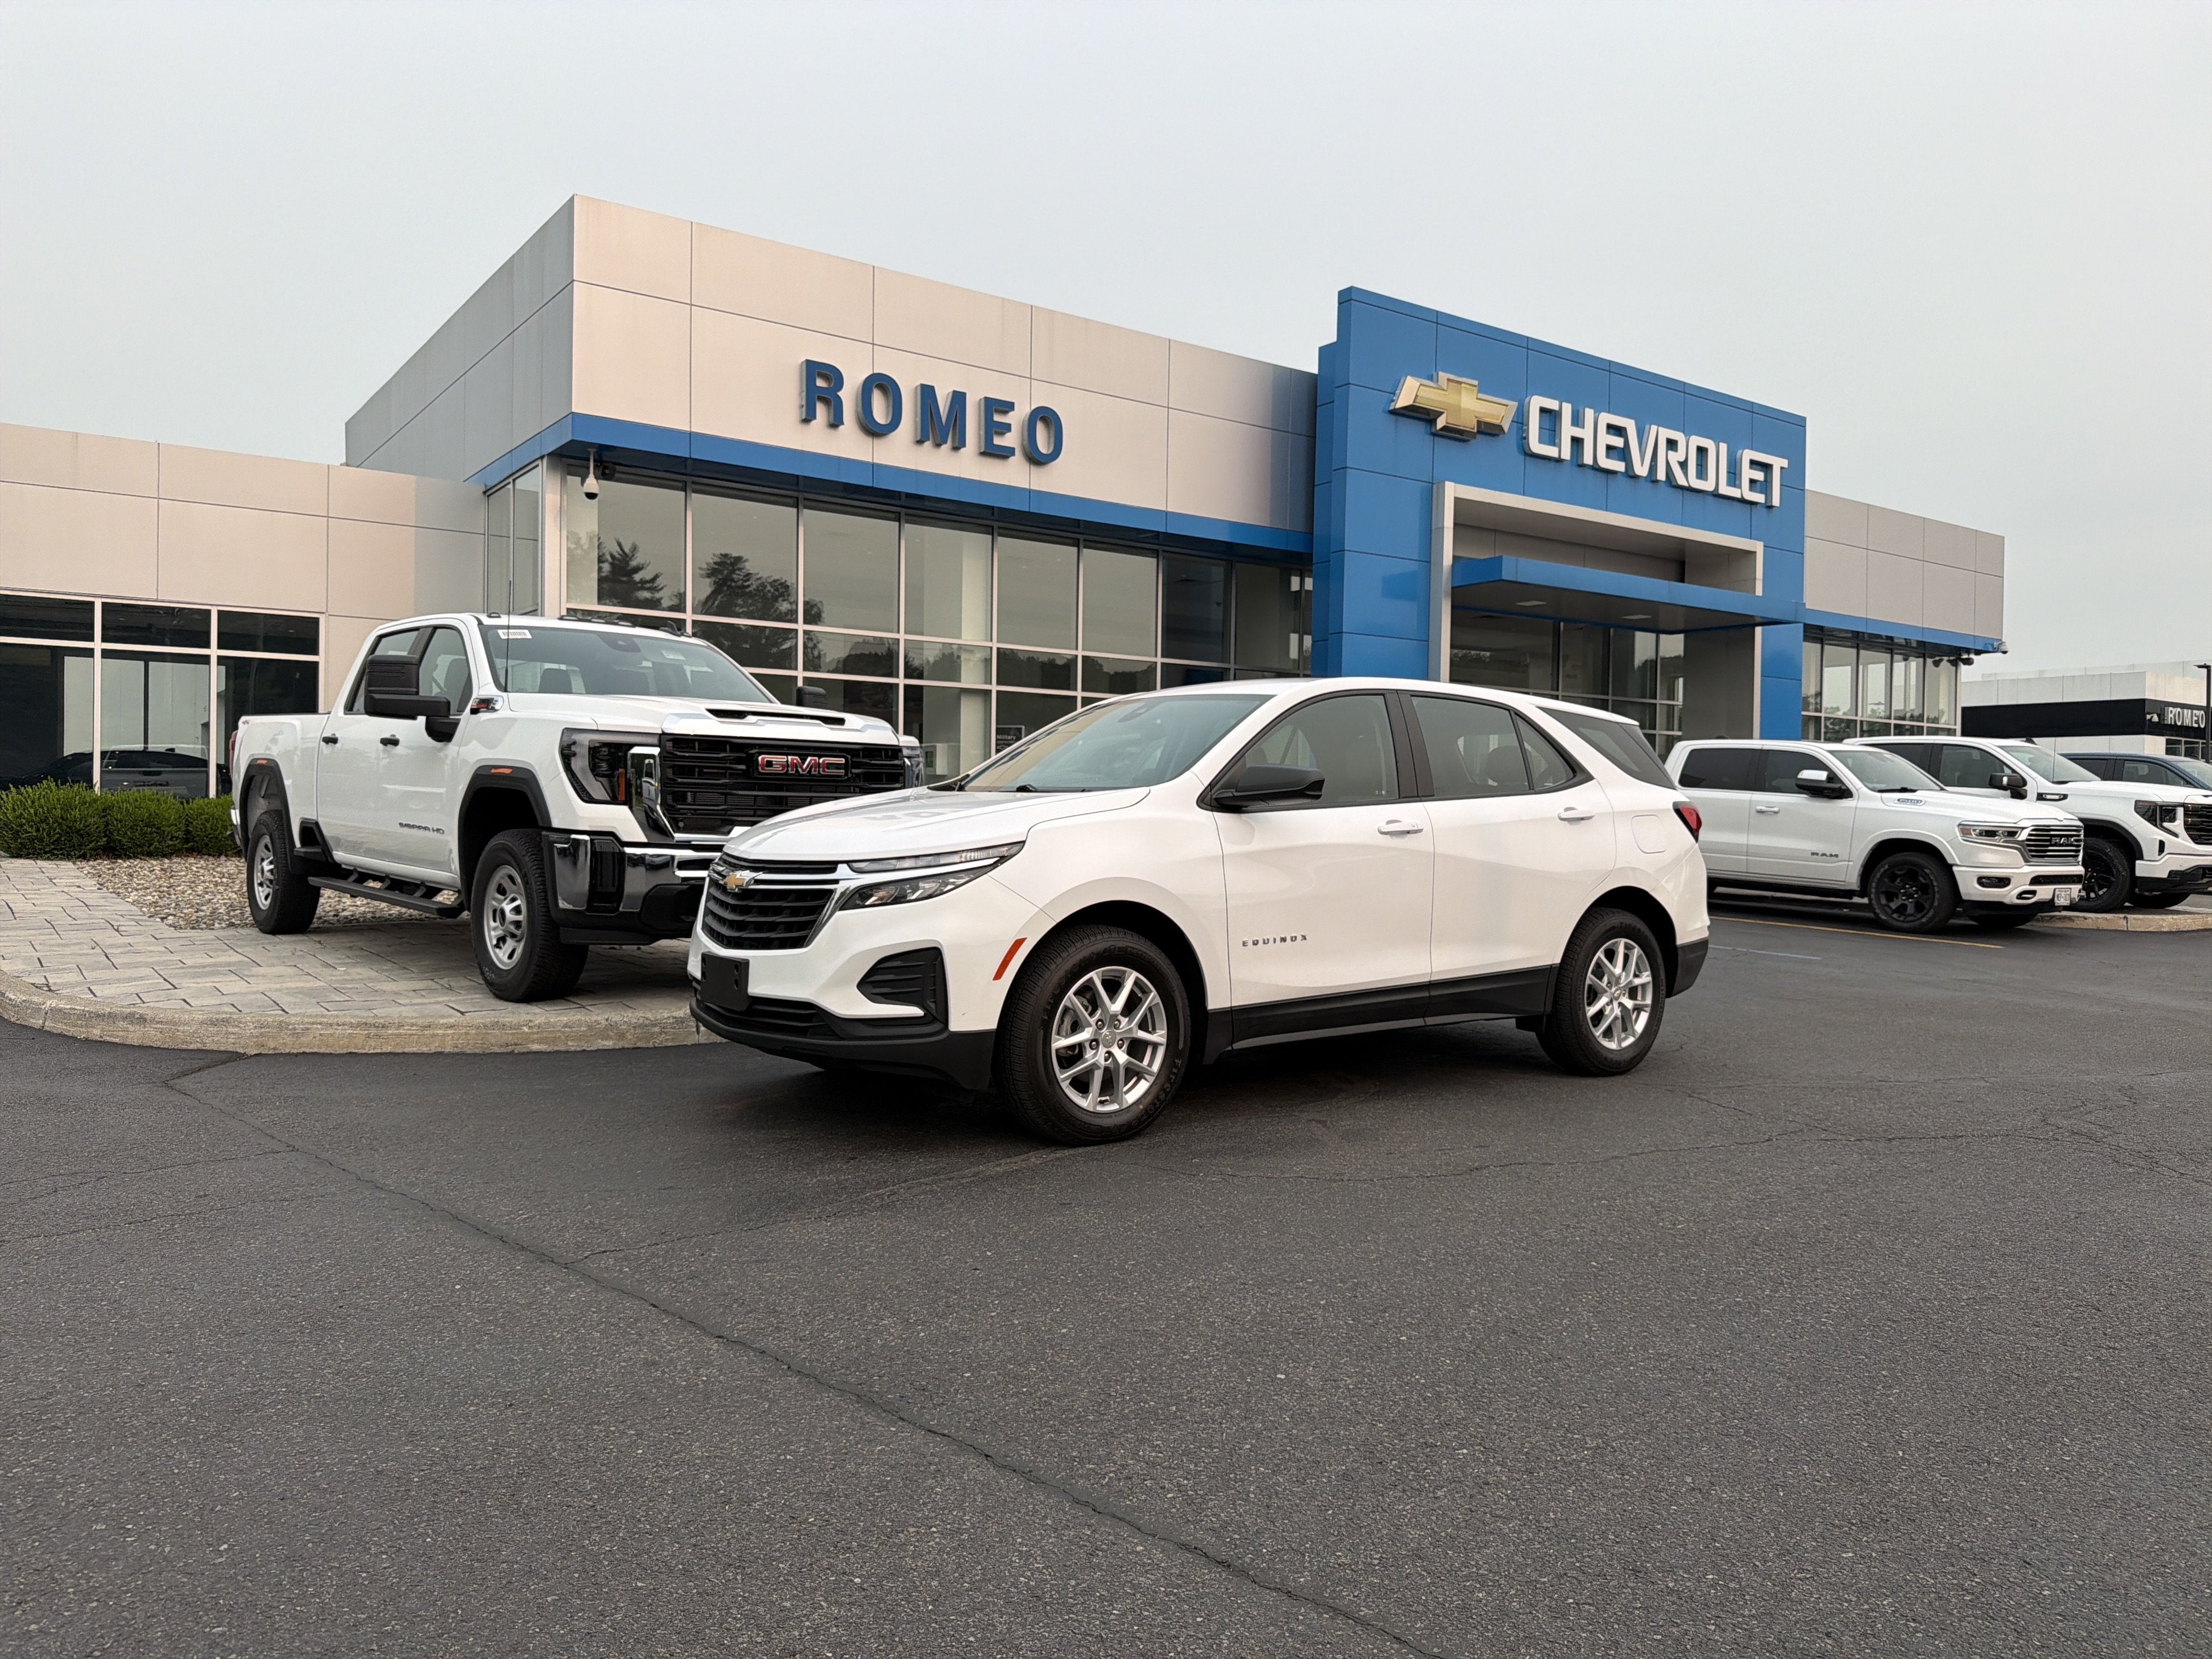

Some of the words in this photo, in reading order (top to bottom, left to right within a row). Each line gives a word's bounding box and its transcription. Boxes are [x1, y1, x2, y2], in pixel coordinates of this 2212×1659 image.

[800, 359, 1063, 465] ROMEO
[1523, 395, 1788, 507] CHEVROLET
[2167, 707, 2205, 728] ROMEO
[758, 754, 845, 775] GMC
[1242, 934, 1307, 947] EQUINOX
